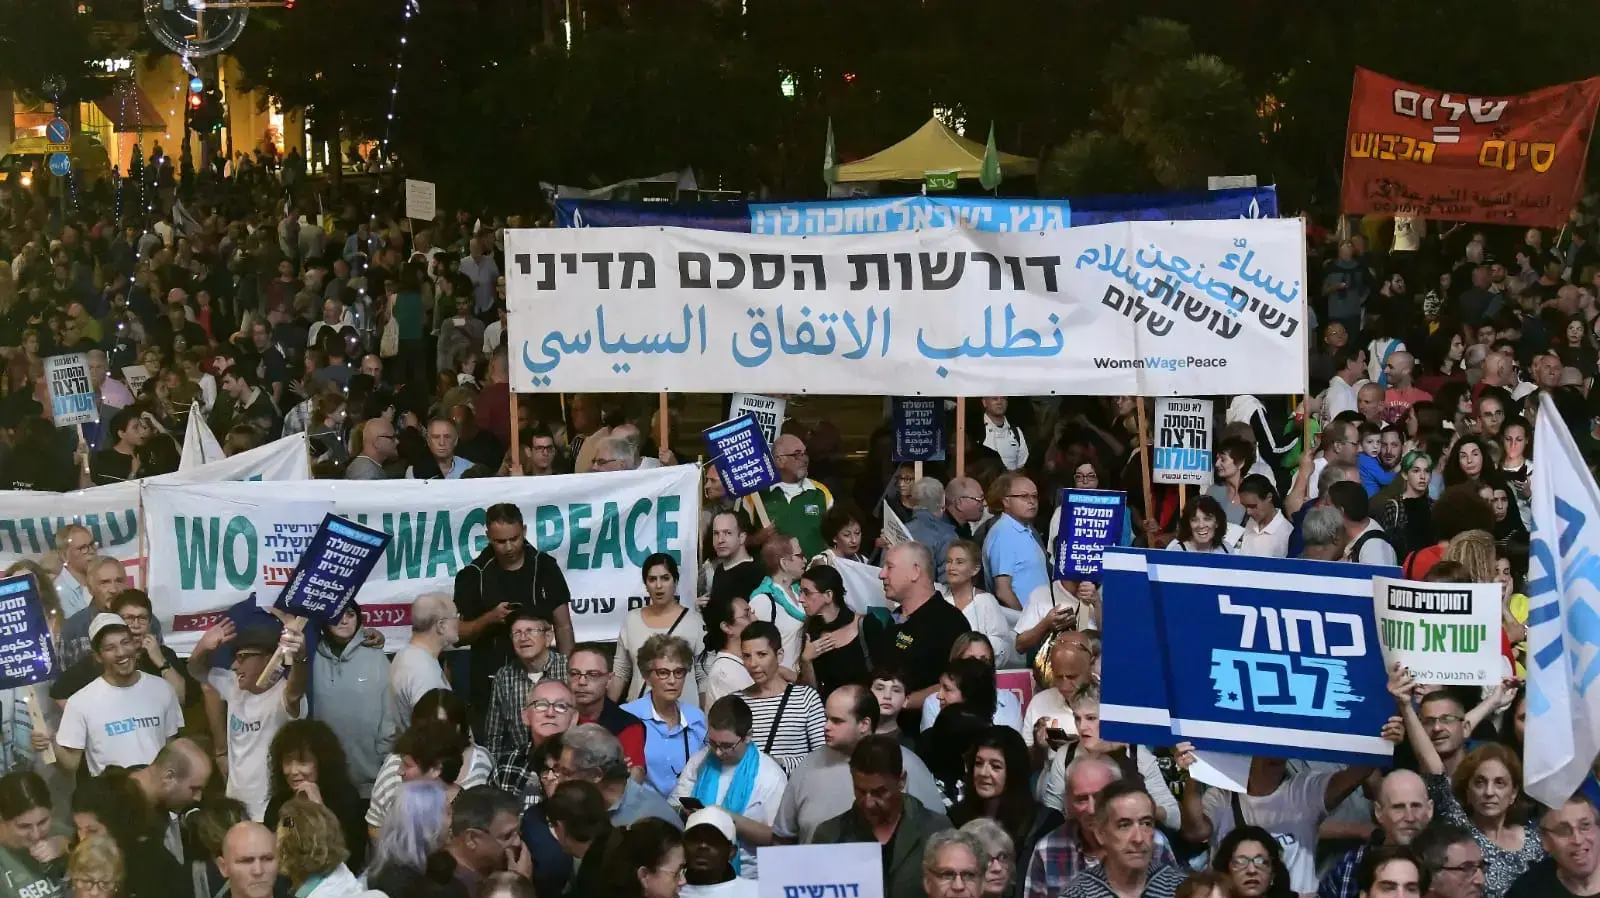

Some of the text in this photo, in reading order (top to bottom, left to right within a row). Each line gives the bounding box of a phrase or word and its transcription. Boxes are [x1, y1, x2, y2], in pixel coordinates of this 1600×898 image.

[1394, 88, 1508, 123] שלום
[1350, 132, 1556, 173] סיום הכבוש
[756, 204, 1064, 236] גנץ, ישראל מחכה לך!
[514, 252, 1061, 292] דורשות הסכם מדיני
[1101, 283, 1175, 337] שלום
[1146, 277, 1243, 340] עושות
[1230, 285, 1299, 338] נשים
[522, 303, 1064, 388] نطلب الاتفاق السياسي
[1094, 355, 1227, 371] WomenWagePeace
[52, 366, 84, 380] ההסתה
[53, 376, 89, 397] הרצח
[743, 397, 775, 409] לא שכחנו
[1167, 402, 1201, 413] לא שכחנו
[737, 408, 776, 425] ההה
[905, 409, 933, 418] יהודית
[906, 417, 932, 426] ערבית
[1163, 414, 1205, 430] ההסתה
[717, 429, 752, 449] ממשלה
[1160, 427, 1207, 449] הרצח
[723, 438, 752, 456] יהודית
[727, 446, 755, 463] ערבית
[731, 458, 760, 473] حكومة
[1154, 448, 1212, 472] השלום
[734, 465, 764, 481] يهودية
[1182, 473, 1202, 481] שלום
[742, 475, 762, 488] عربية
[1073, 506, 1113, 518] ממשלה
[273, 523, 320, 533] דורשים
[1074, 517, 1109, 529] יהודית
[265, 533, 315, 547] משלת
[382, 495, 682, 581] WAG PEACE
[1074, 527, 1107, 539] ערבית
[272, 548, 302, 563] לום.
[326, 536, 370, 559] ממשלה
[322, 549, 361, 567] יהודית
[263, 564, 297, 581] שיו!
[317, 560, 354, 578] ערבית
[1074, 561, 1098, 574] عربية
[308, 573, 345, 591] حكومة
[303, 584, 338, 604] يهودية
[1390, 588, 1468, 613] דמוקרטיה חזקה
[0, 596, 27, 612] ממש
[301, 594, 327, 612] عربية
[571, 595, 681, 614] ים עוש
[0, 609, 26, 624] יהוד
[183, 613, 223, 628] יני.
[360, 608, 405, 624] עוצר
[0, 621, 28, 636] ערבי
[1218, 593, 1367, 657] כחול
[1380, 617, 1486, 653] ישראל חזקה
[0, 638, 35, 654] حكوم
[0, 650, 36, 666] يهودي
[5, 663, 35, 678] عربية
[1436, 670, 1474, 680] התנועה
[1226, 653, 1340, 713] לבן
[132, 716, 160, 728] כחול
[783, 883, 859, 898] דורשים
